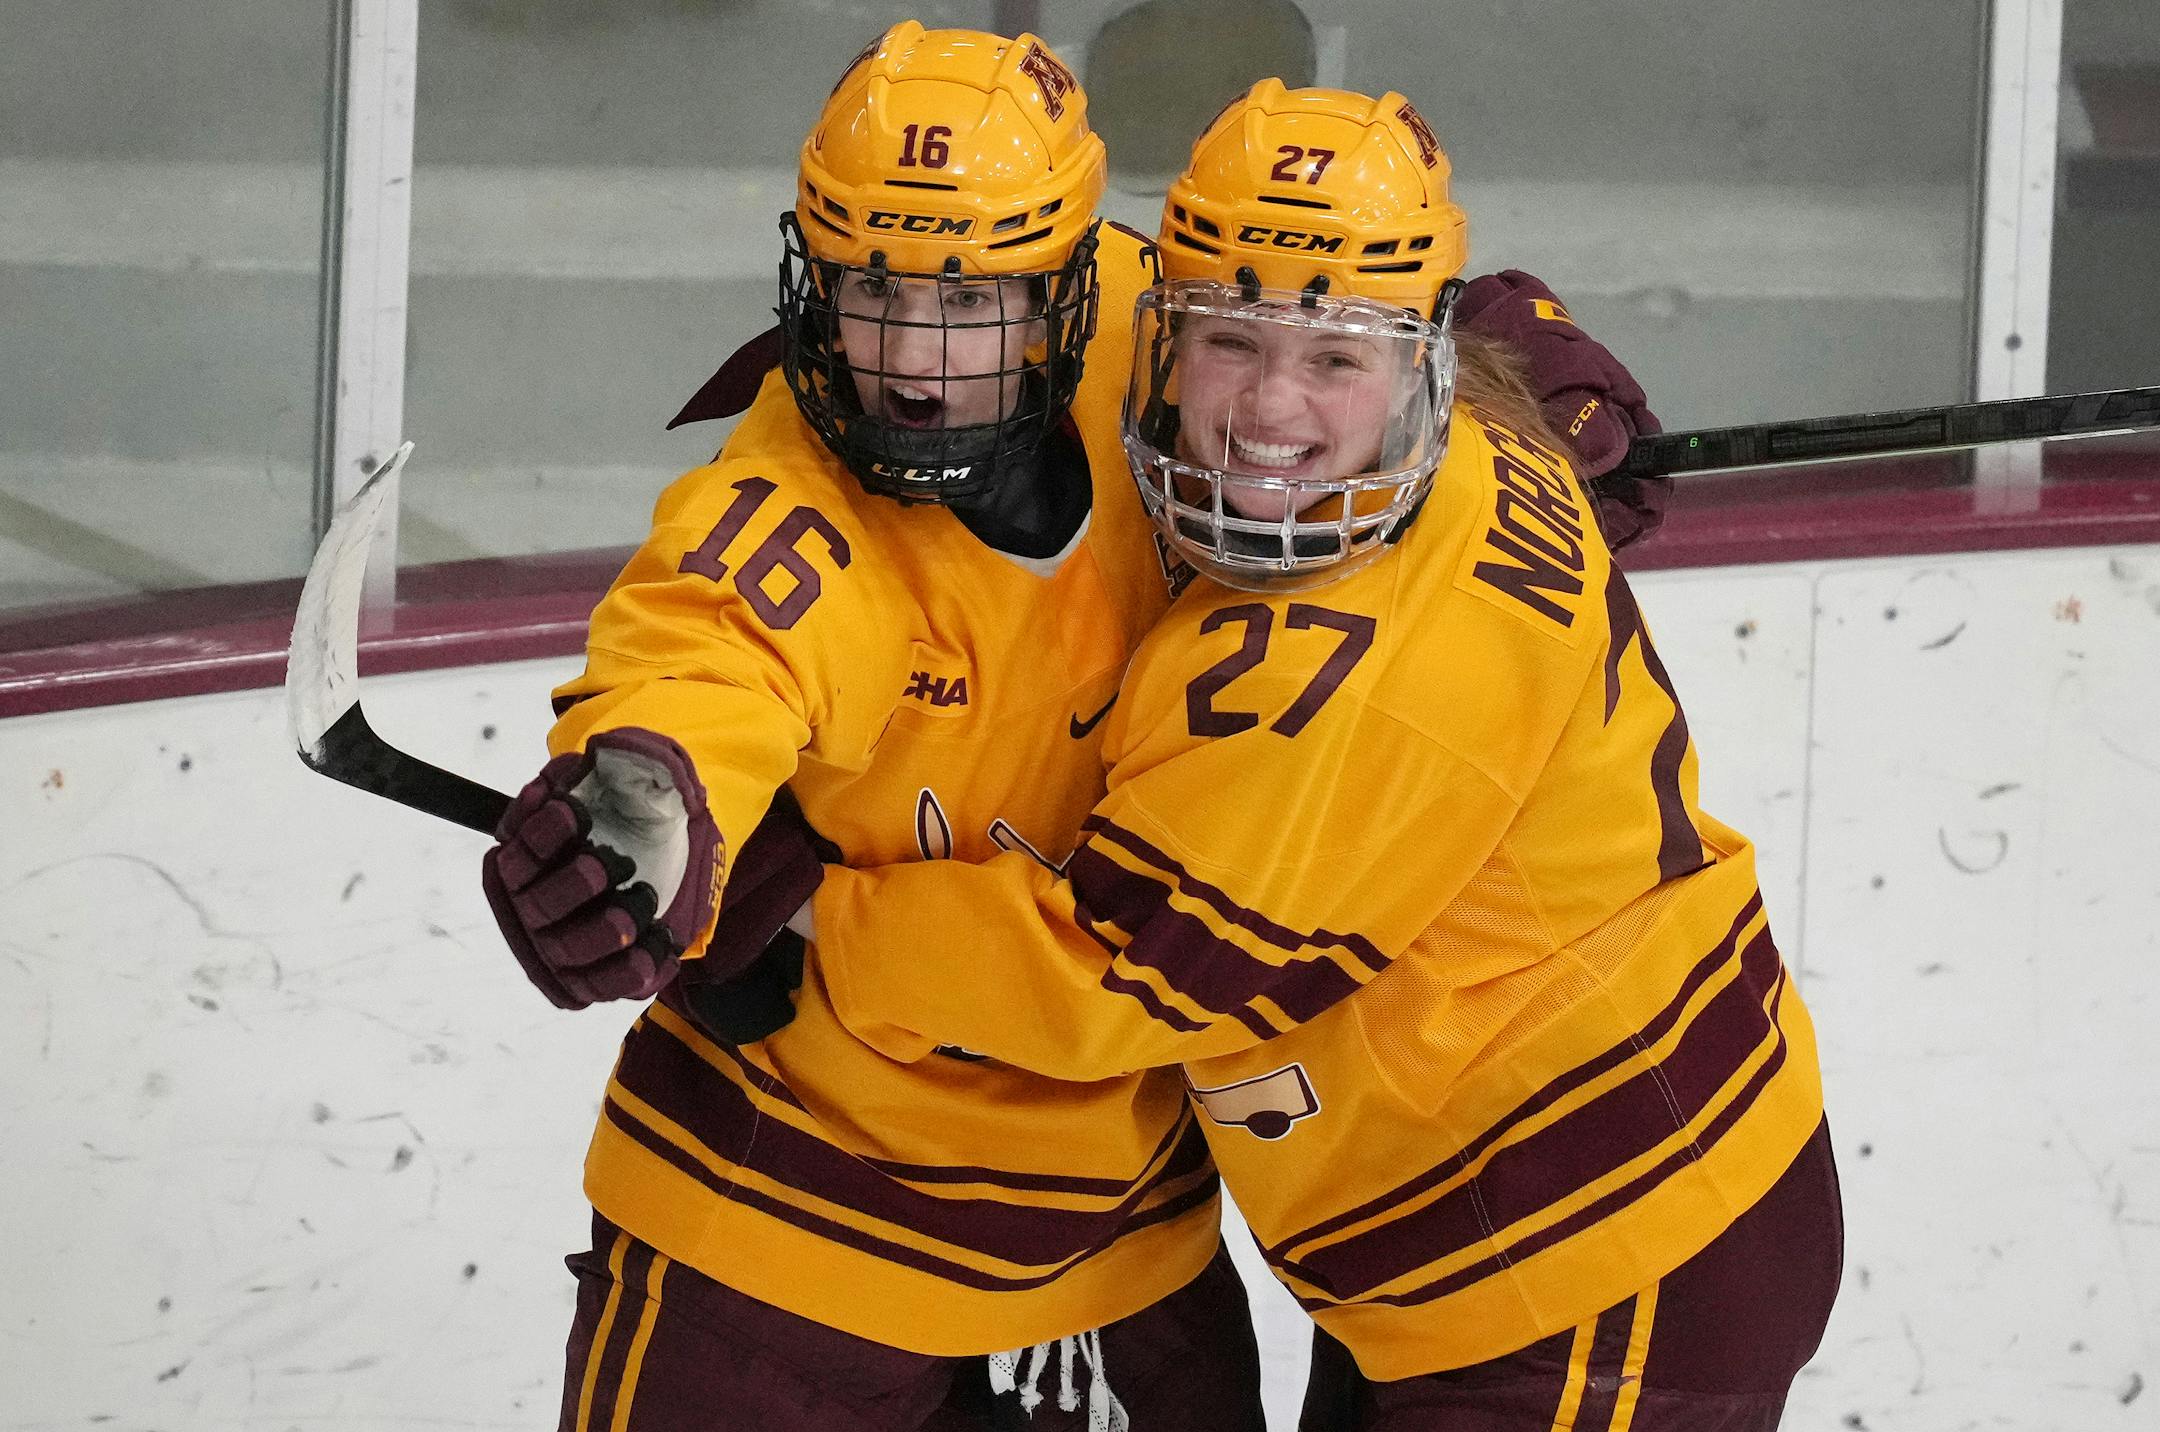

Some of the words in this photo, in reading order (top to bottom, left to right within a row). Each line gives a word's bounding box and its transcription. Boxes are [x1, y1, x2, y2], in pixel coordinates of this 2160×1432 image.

[898, 123, 952, 169] 16
[1270, 144, 1336, 185] 27
[865, 210, 974, 236] CCM
[1236, 224, 1348, 253] CCM
[1568, 399, 1599, 437] CCM
[1689, 437, 1699, 448] 6
[677, 475, 852, 630] 16
[1185, 602, 1377, 738] 27
